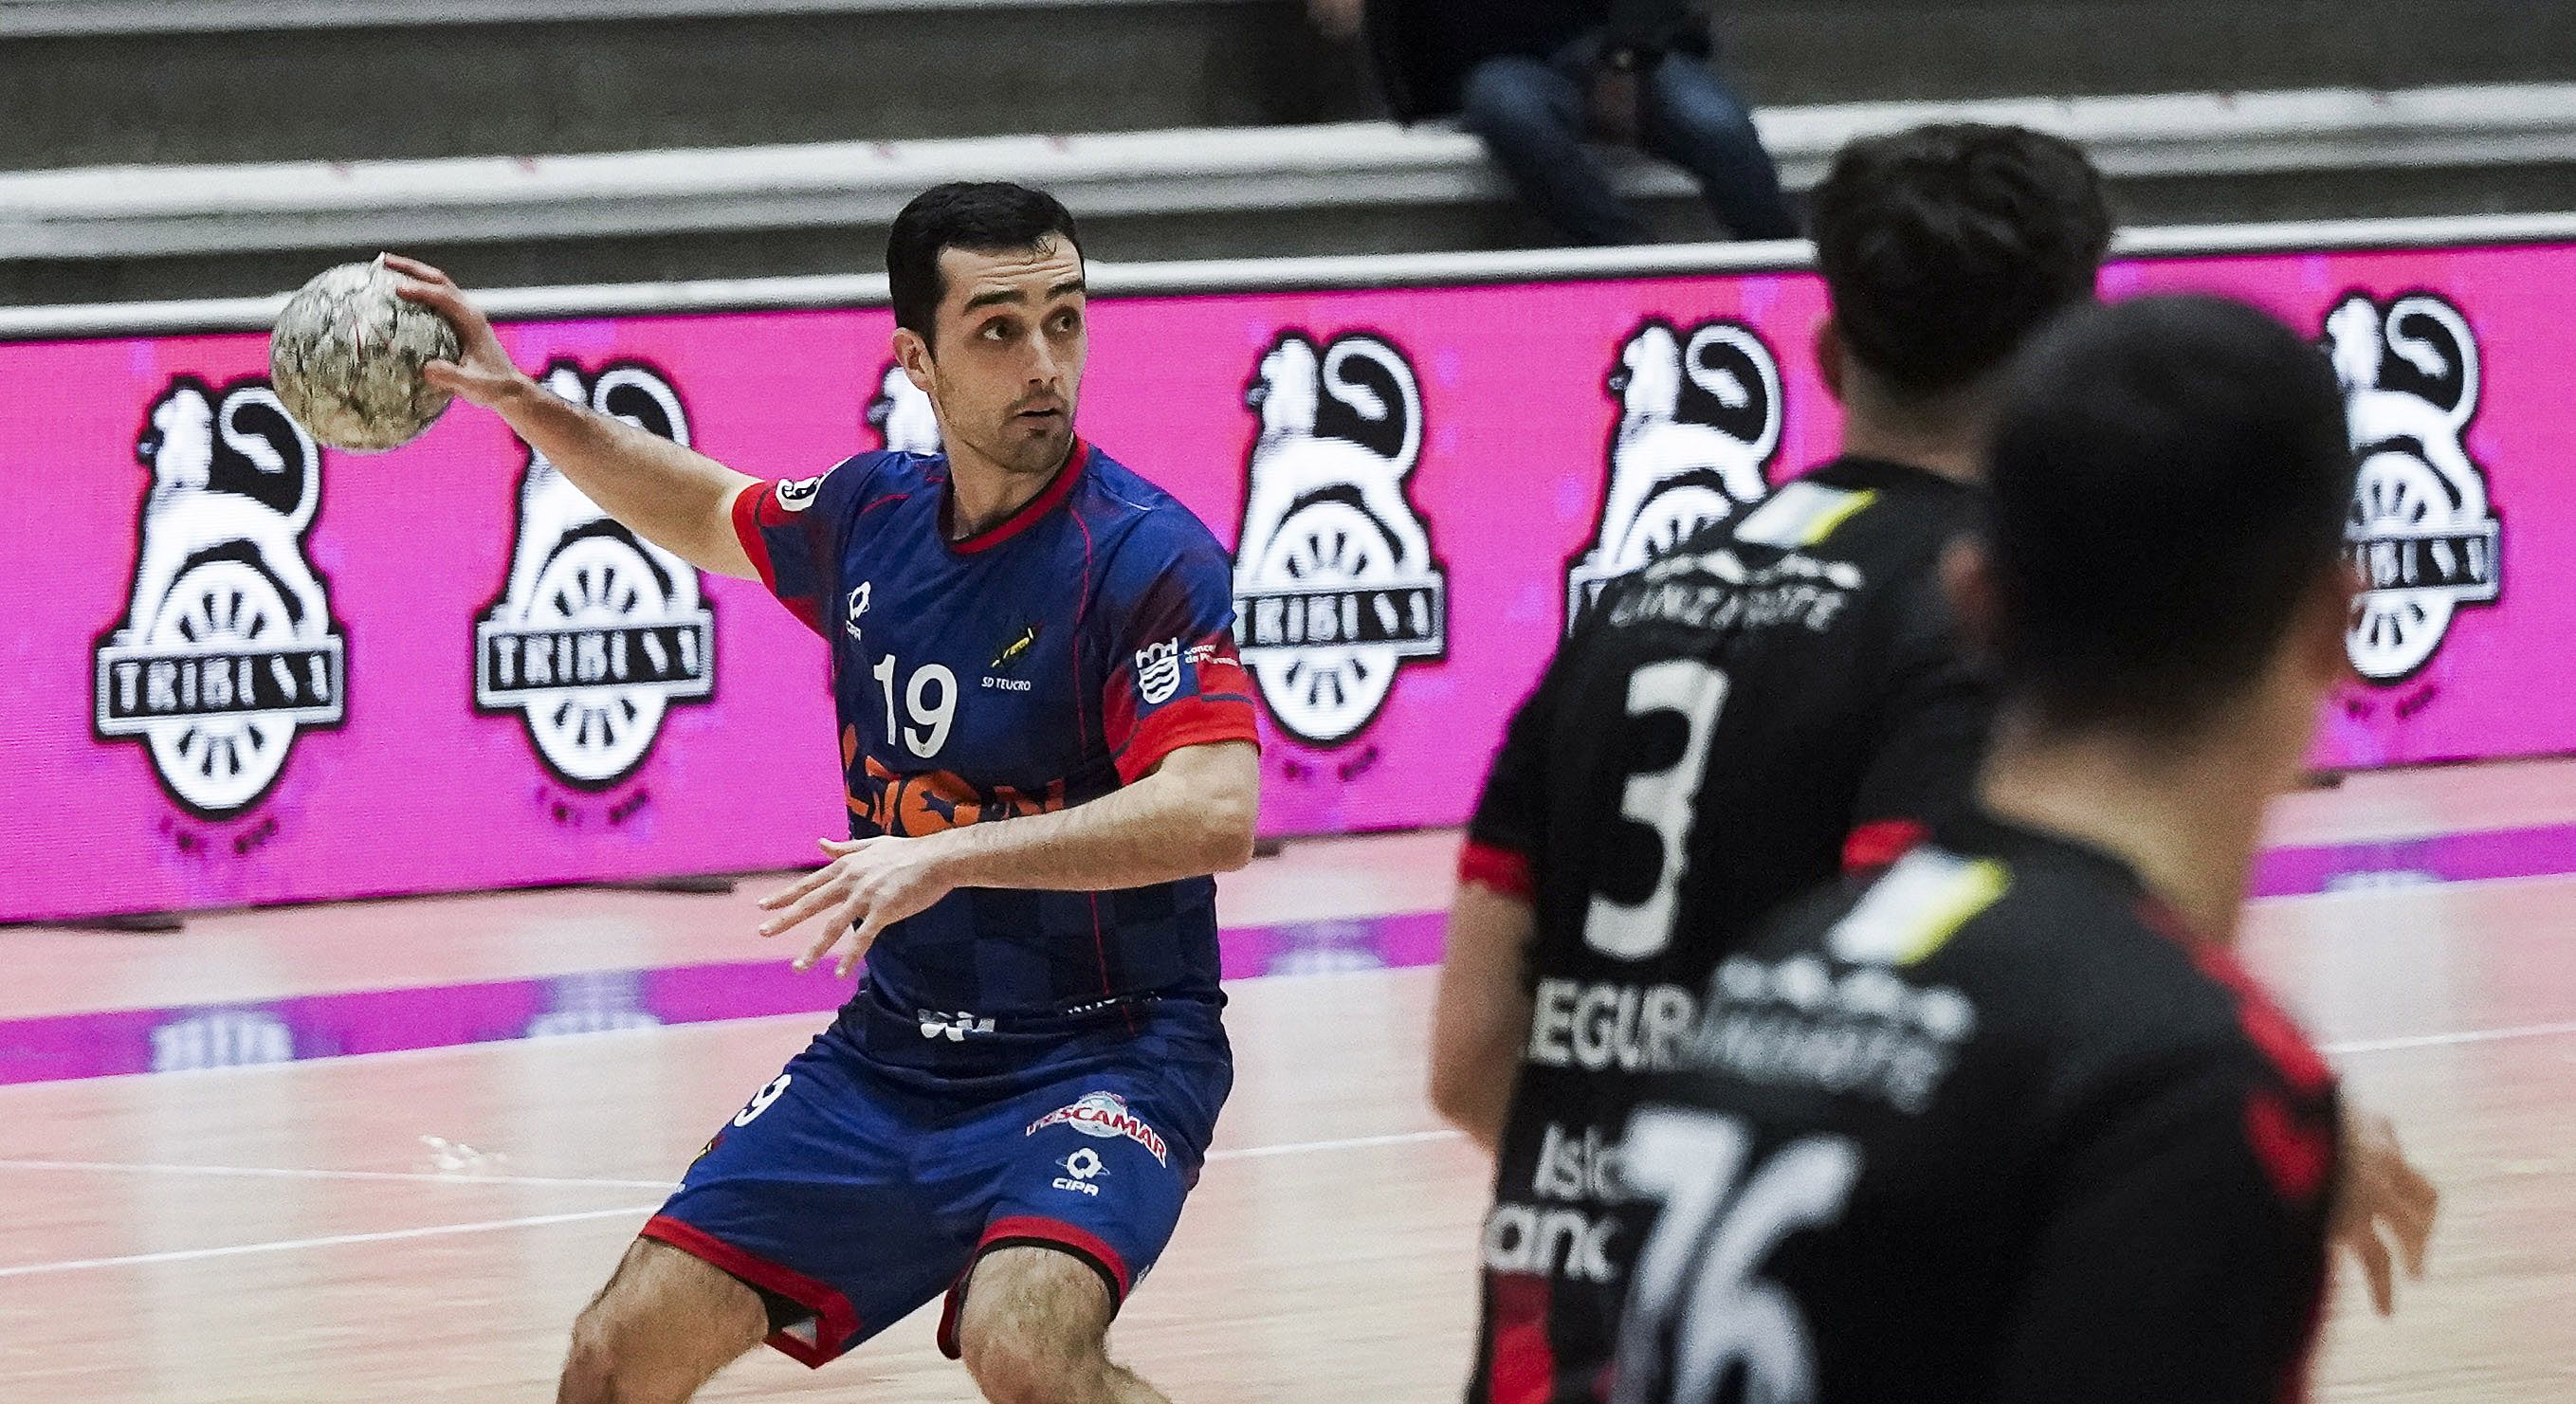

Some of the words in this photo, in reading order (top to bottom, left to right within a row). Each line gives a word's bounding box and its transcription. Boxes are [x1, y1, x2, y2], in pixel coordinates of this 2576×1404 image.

[873, 654, 958, 758] 19
[981, 676, 995, 688] SD
[996, 678, 1032, 691] TEUCRO
[1582, 659, 1731, 962] 3
[733, 1073, 793, 1128] 9
[1051, 1177, 1100, 1196] CIPA
[1602, 1103, 1870, 1404] 76
